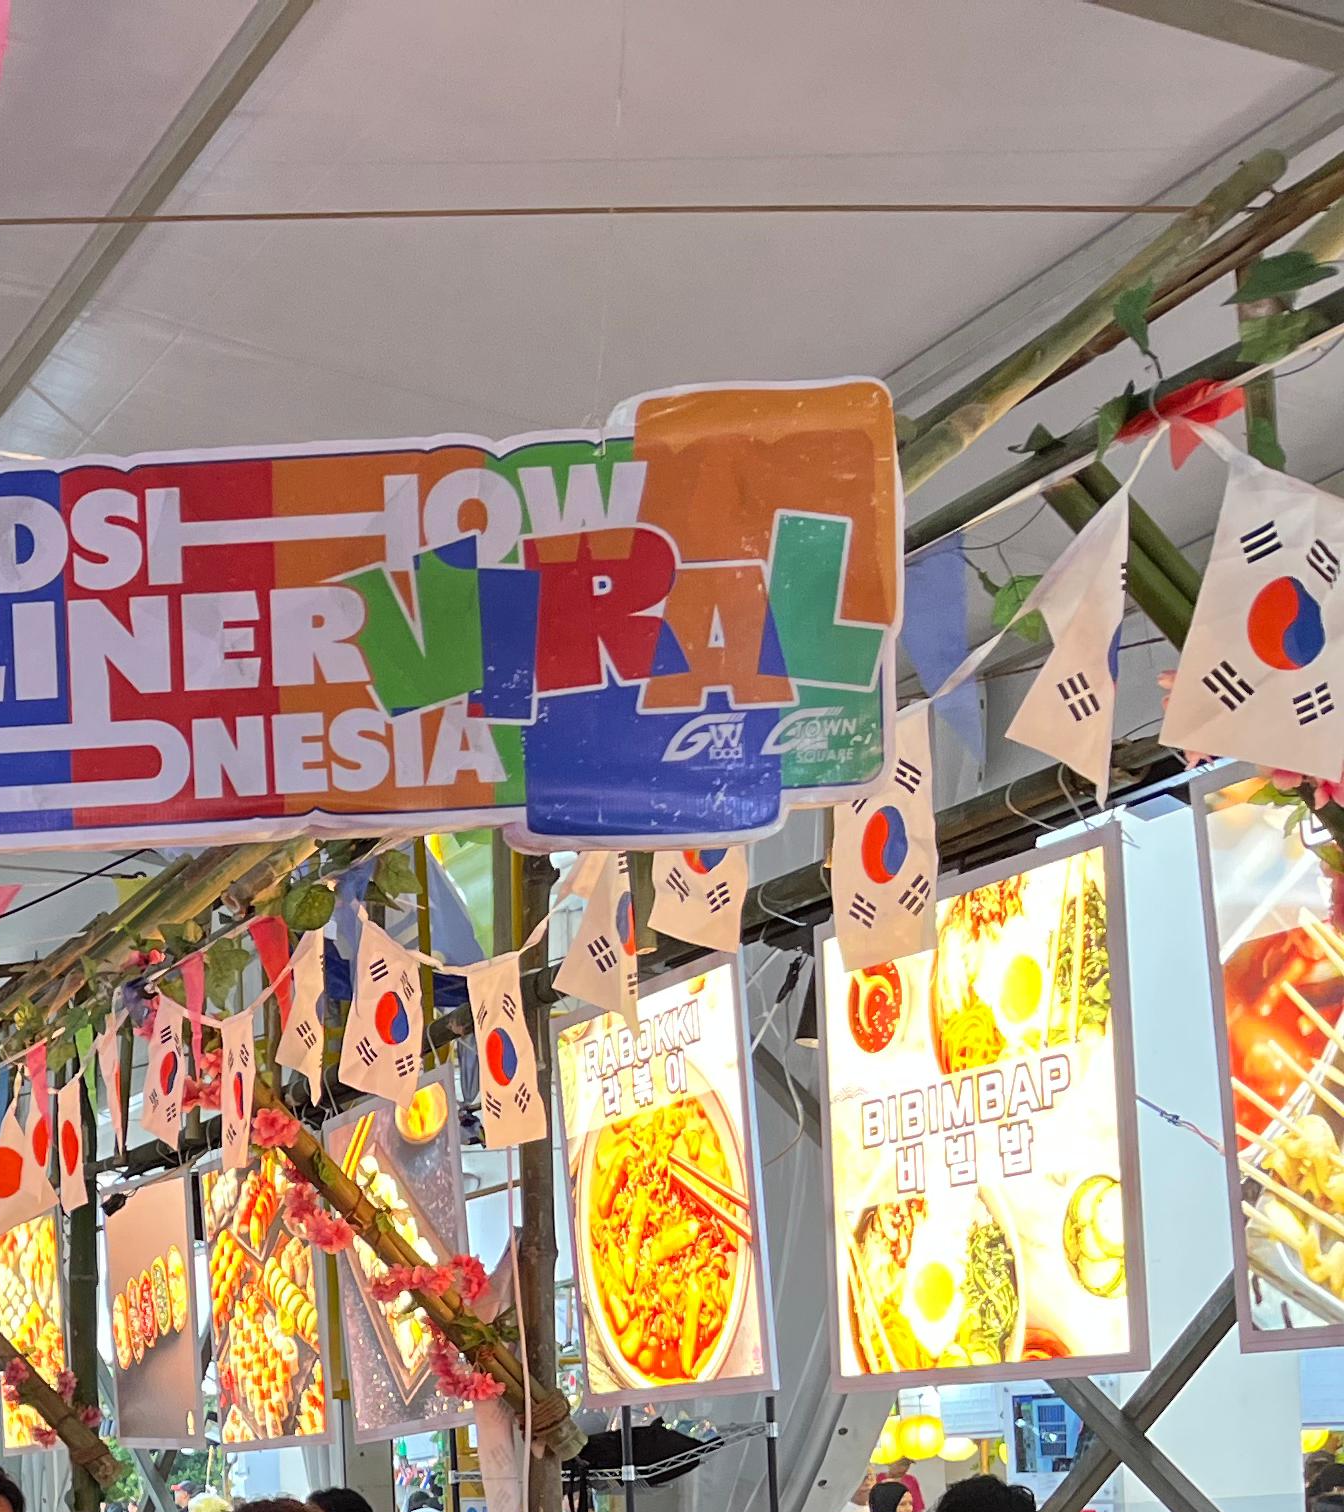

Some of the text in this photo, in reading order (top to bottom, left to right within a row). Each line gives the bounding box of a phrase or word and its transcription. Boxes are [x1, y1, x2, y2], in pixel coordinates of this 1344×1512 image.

[338, 508, 884, 726] VIRAL
[584, 998, 701, 1082] RABOKKI
[861, 1053, 1071, 1149] BIBIMBAP
